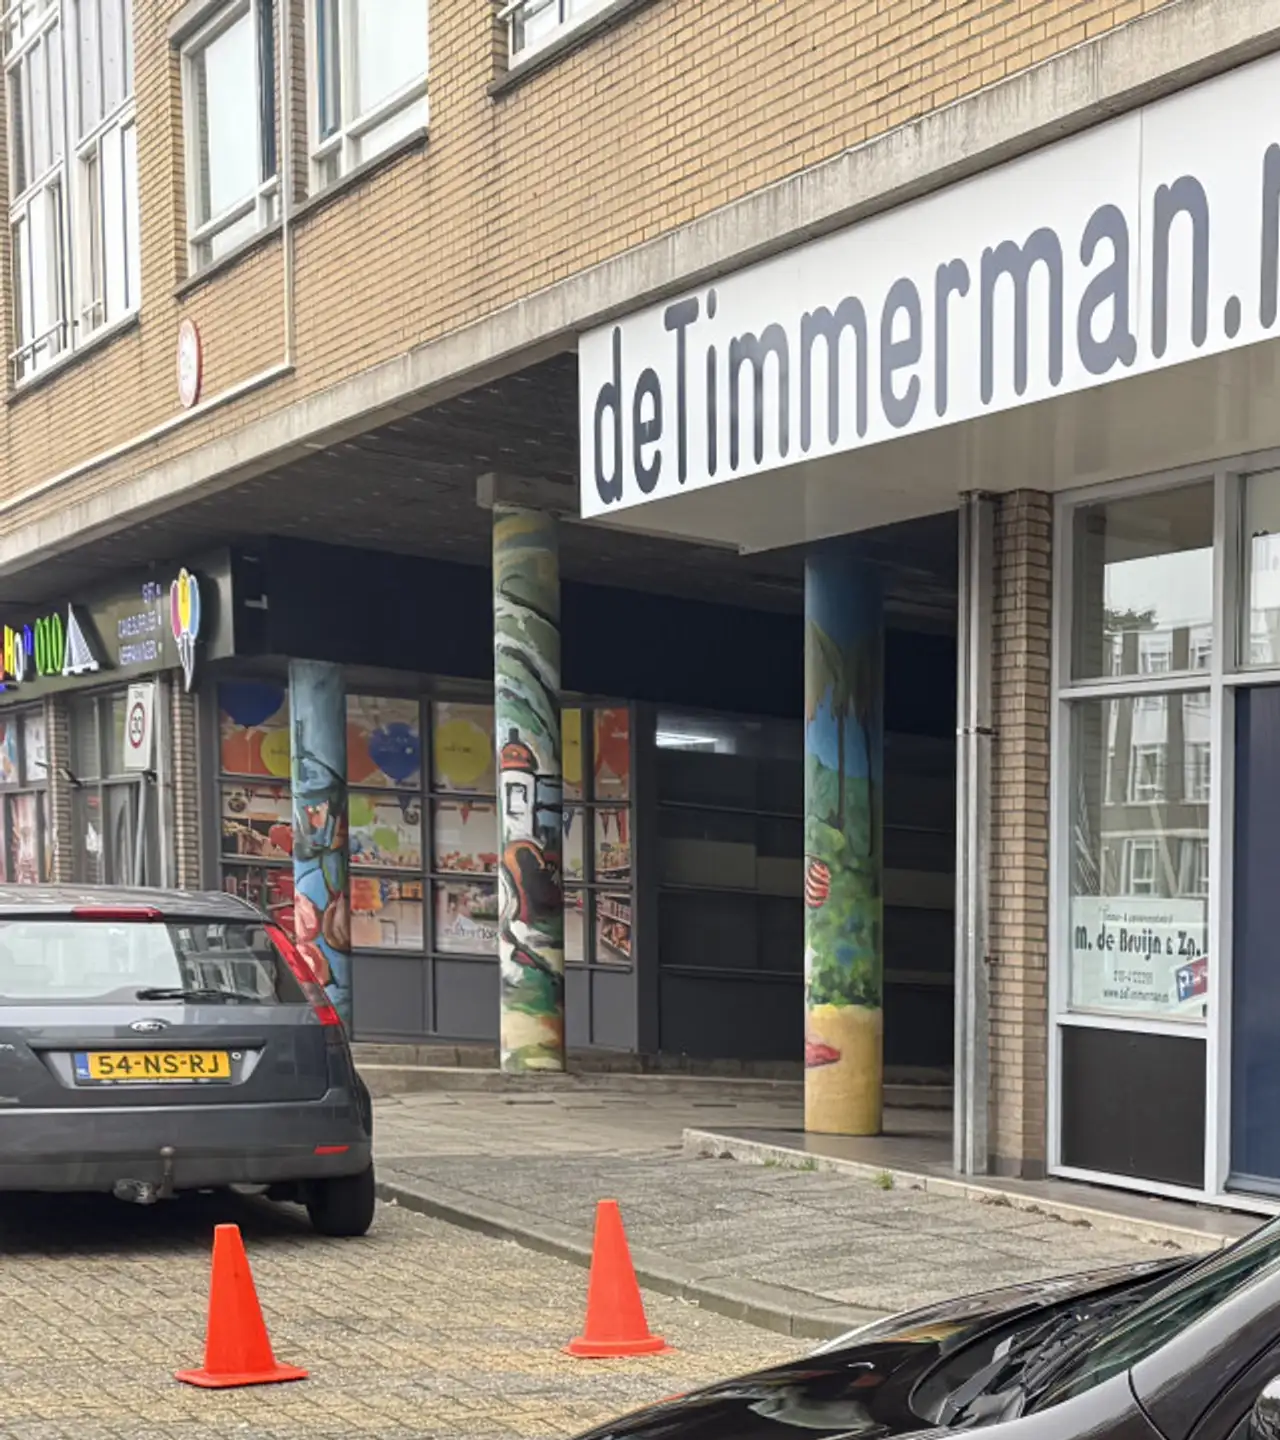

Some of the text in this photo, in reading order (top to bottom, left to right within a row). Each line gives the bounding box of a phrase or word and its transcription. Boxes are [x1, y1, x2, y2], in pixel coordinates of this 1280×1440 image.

[1097, 923, 1115, 951] de
[1120, 927, 1161, 961] Bruijn
[99, 1054, 220, 1075] 54-NS-RJ
